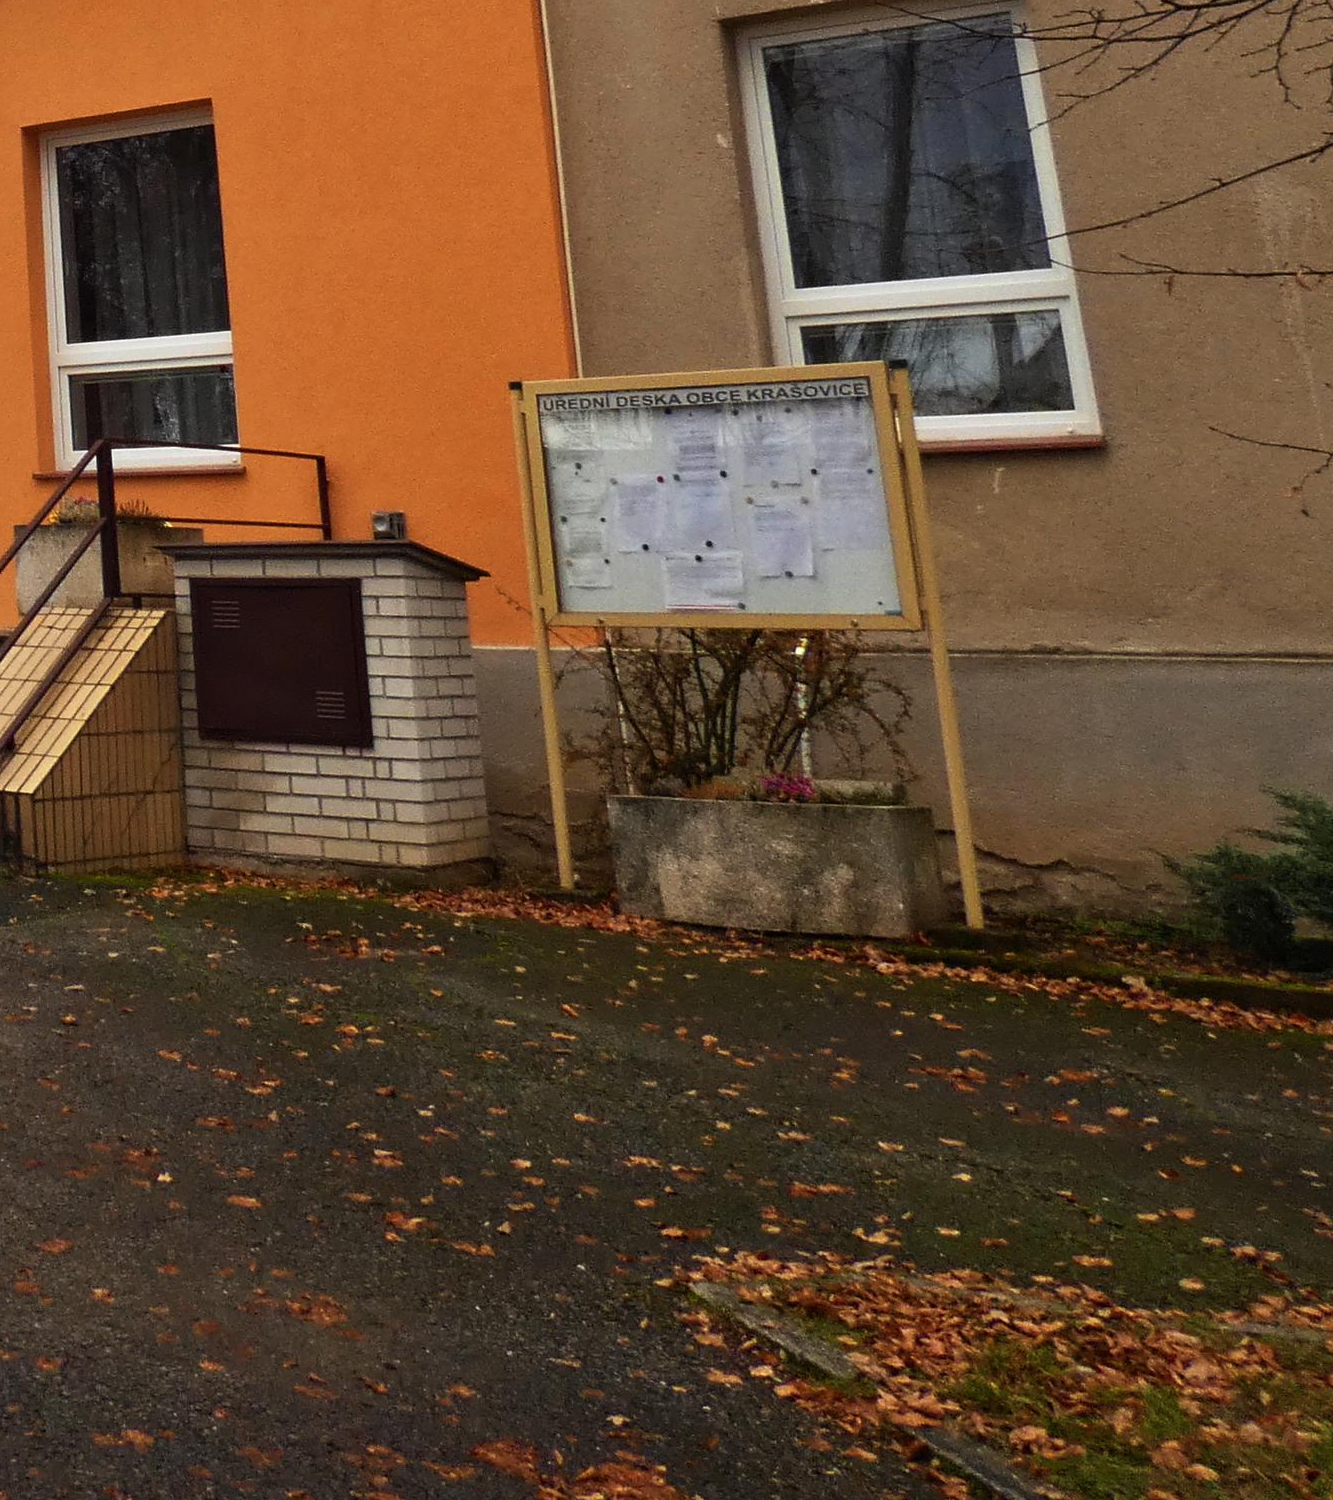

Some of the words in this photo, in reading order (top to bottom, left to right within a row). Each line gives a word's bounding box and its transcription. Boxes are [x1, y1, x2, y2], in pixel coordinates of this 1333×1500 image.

[616, 393, 681, 408] DESKA
[686, 389, 742, 404] OBCE
[746, 382, 866, 401] KRAŠOVICE
